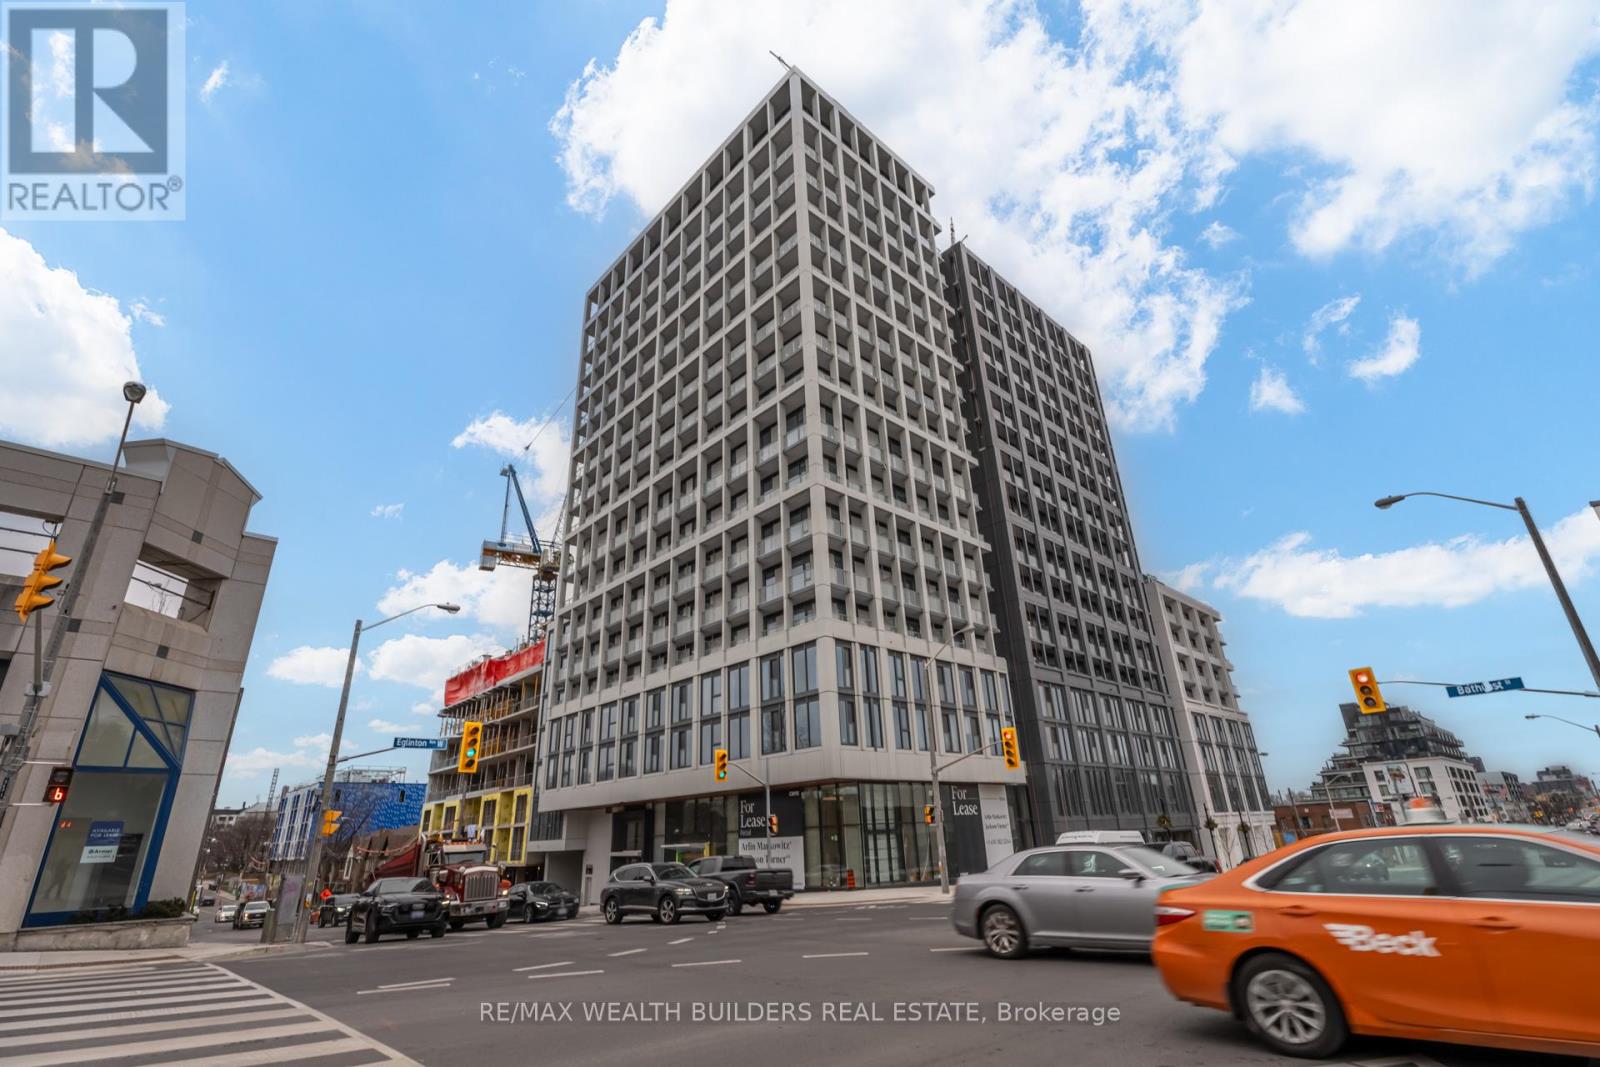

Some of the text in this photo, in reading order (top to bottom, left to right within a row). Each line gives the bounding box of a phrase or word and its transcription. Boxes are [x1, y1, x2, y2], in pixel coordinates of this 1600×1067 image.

[1456, 681, 1504, 695] Bathst
[396, 738, 427, 748] Eglinton
[437, 740, 444, 748] W
[951, 785, 967, 800] For
[740, 800, 755, 814] For
[952, 801, 979, 816] Lease
[740, 814, 766, 828] Lease
[1322, 922, 1443, 957] Beck
